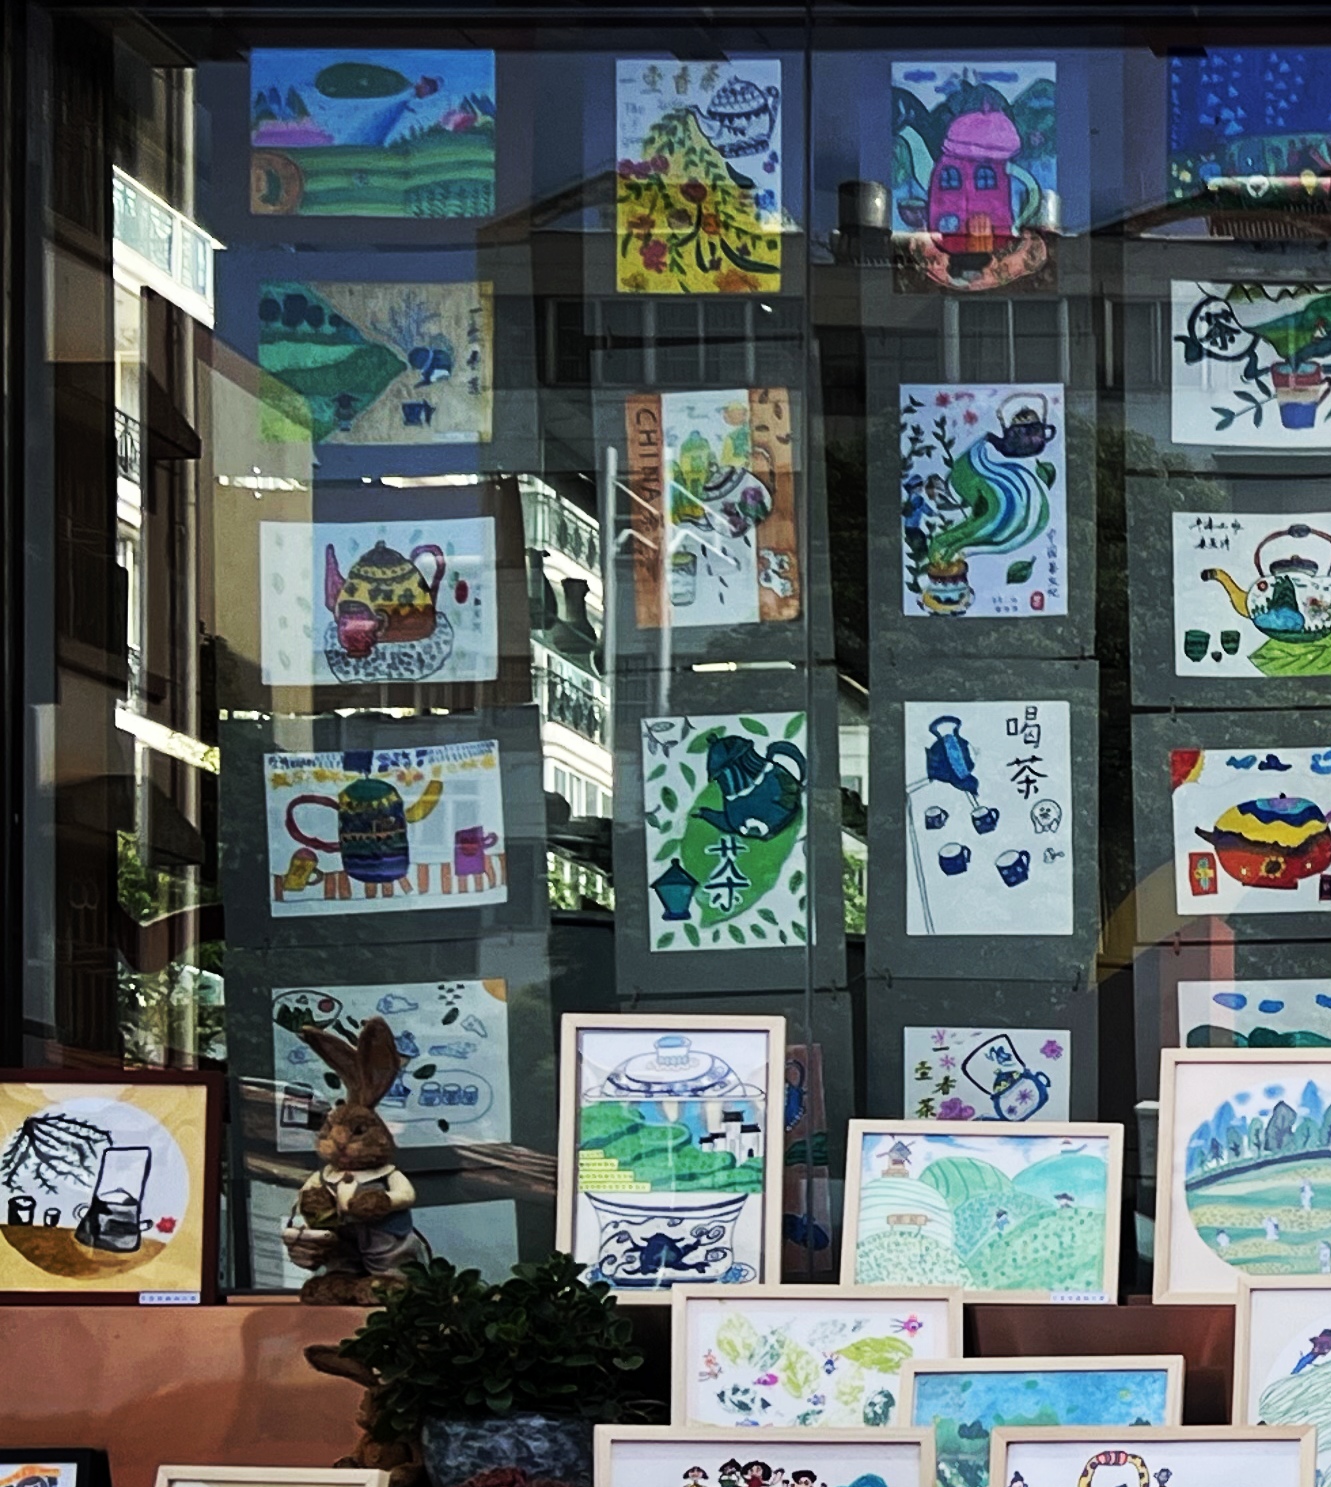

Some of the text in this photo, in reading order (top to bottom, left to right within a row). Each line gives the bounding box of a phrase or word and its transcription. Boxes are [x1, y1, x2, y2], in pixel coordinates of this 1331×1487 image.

[1200, 309, 1241, 351] 茶
[636, 408, 662, 502] CHINA
[1006, 705, 1048, 800] 喝茶
[704, 835, 750, 912] 茶
